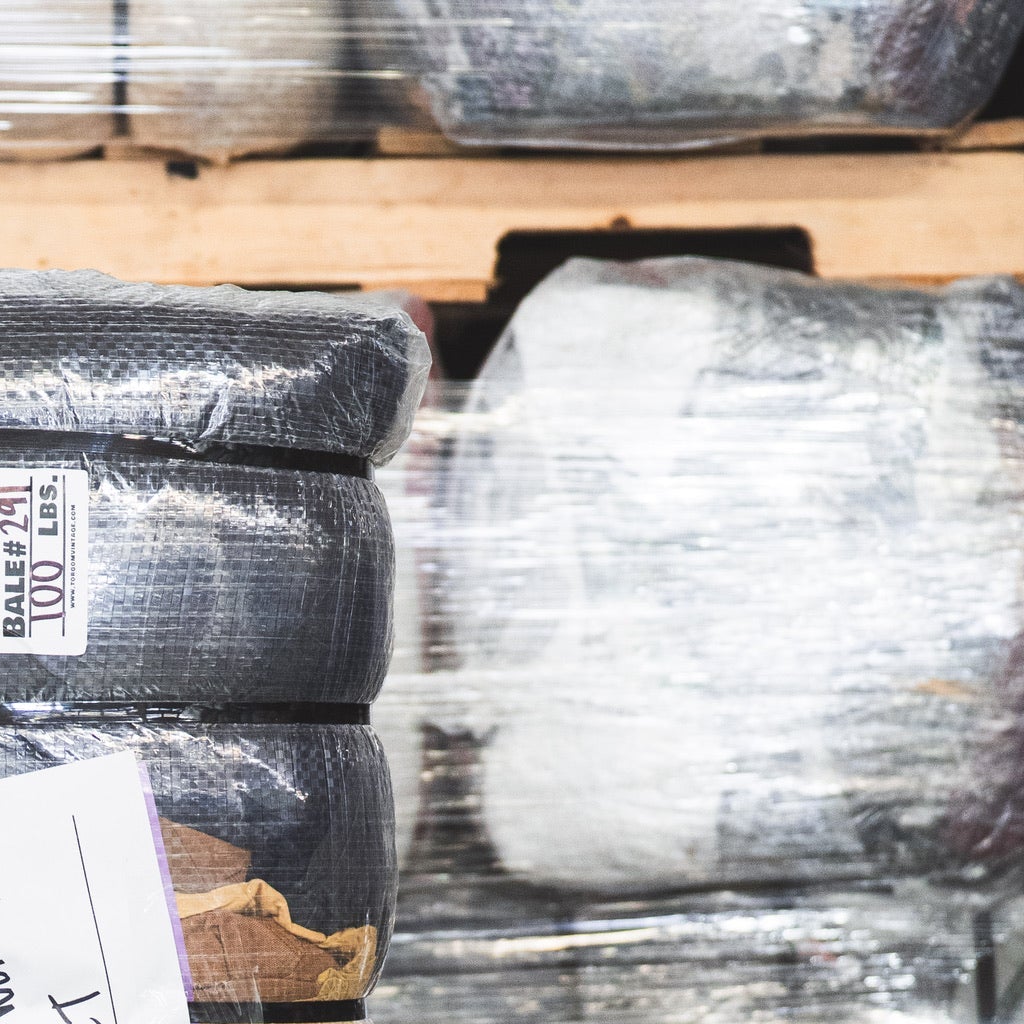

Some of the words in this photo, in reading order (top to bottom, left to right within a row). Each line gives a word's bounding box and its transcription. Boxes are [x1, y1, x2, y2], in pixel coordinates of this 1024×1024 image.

[37, 475, 59, 537] LBS.
[2, 539, 27, 638] BALE#
[28, 560, 67, 622] 100
